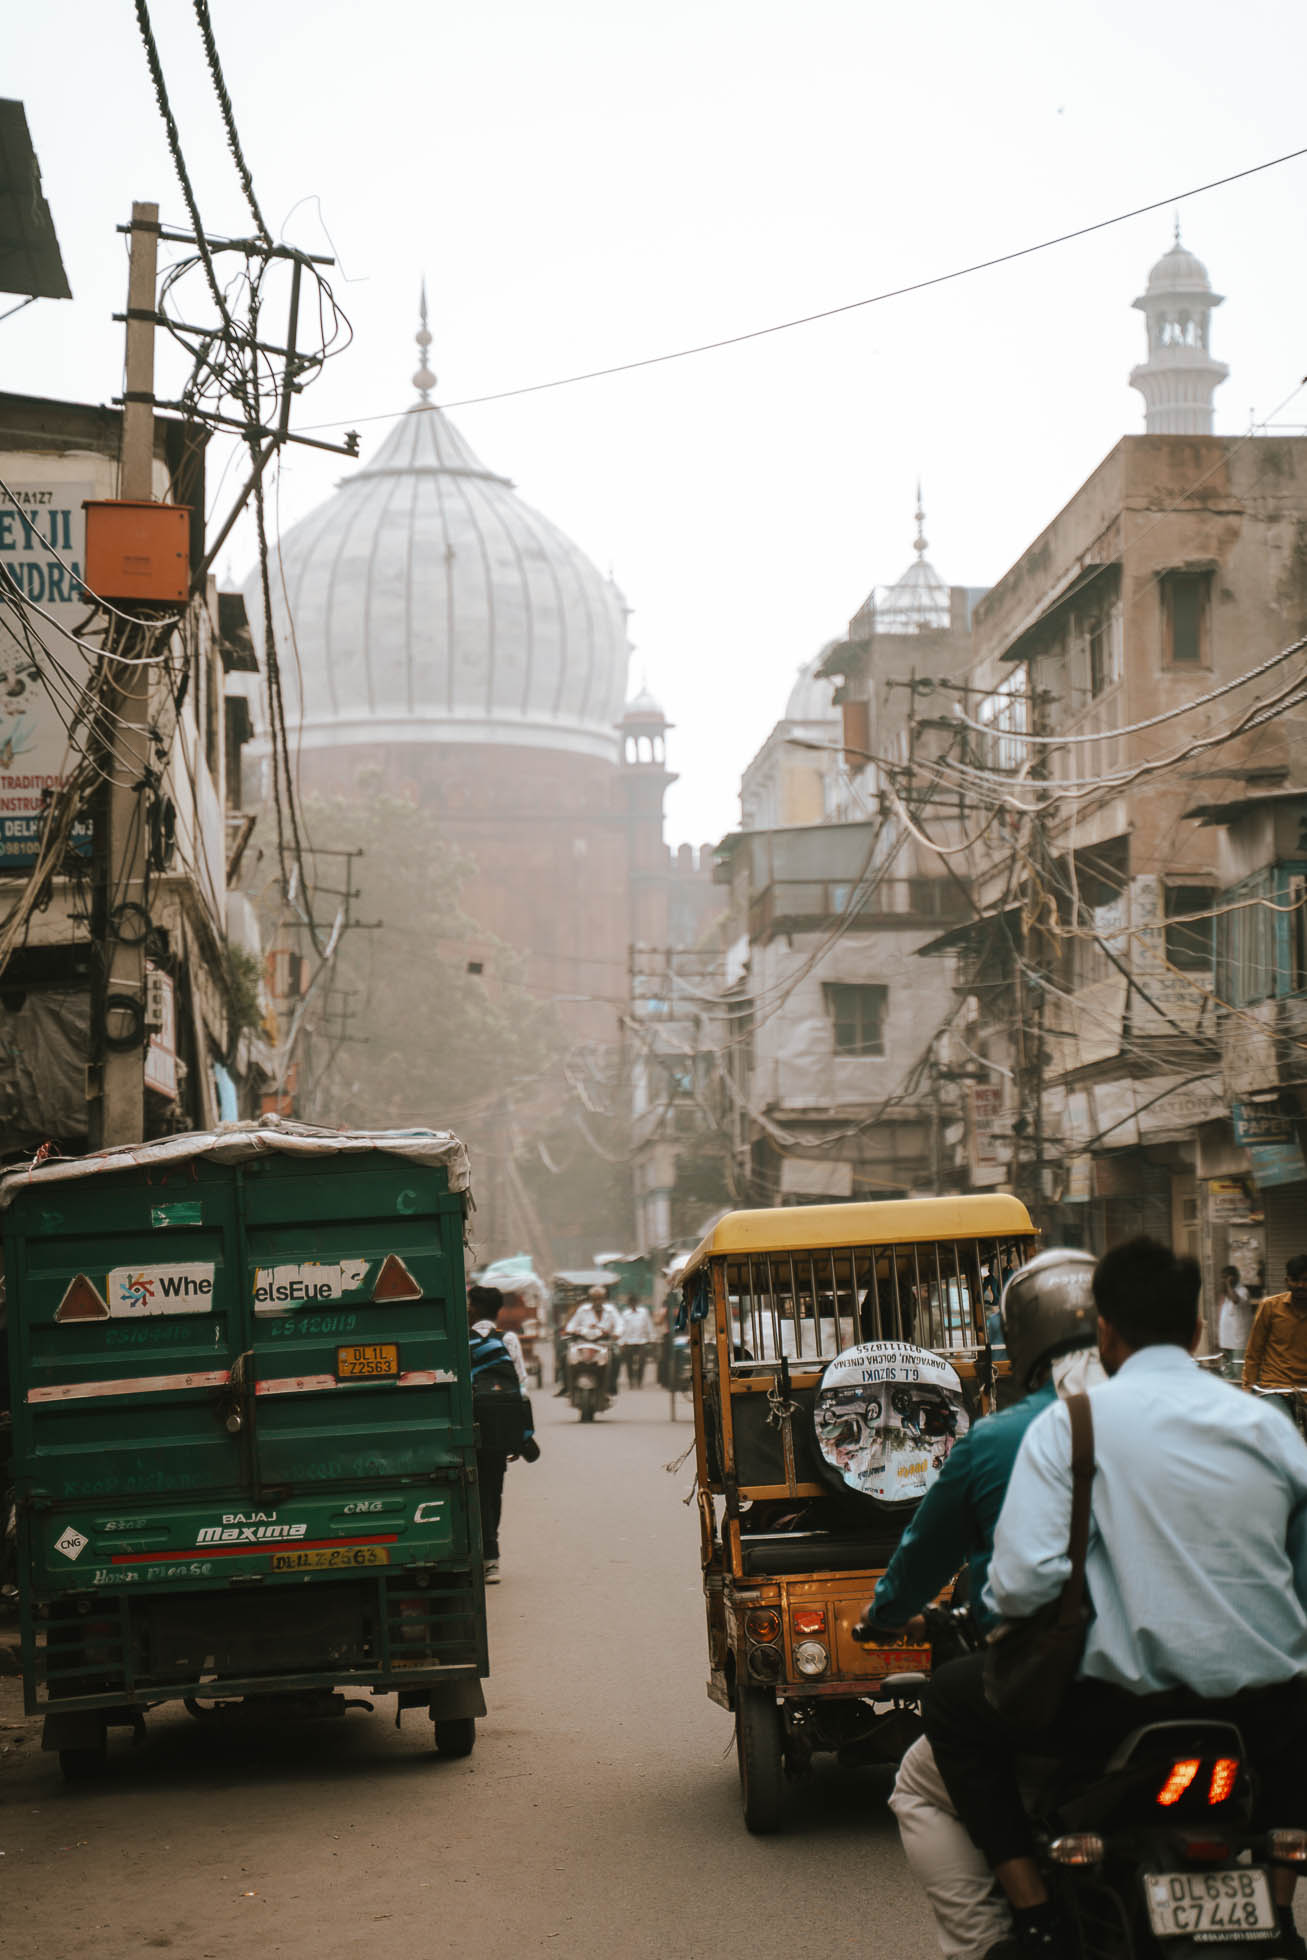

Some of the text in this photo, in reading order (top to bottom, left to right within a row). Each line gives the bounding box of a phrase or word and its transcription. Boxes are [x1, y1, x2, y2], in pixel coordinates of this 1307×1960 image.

[158, 1276, 213, 1298] Whe
[350, 1361, 392, 1374] Z2563
[862, 1367, 897, 1382] SUZUKI
[222, 1512, 277, 1524] BAJAJ
[414, 1501, 445, 1523] C
[60, 1538, 81, 1550] CNG
[1169, 1872, 1255, 1901] DL6SB
[1172, 1901, 1258, 1930] C7448
